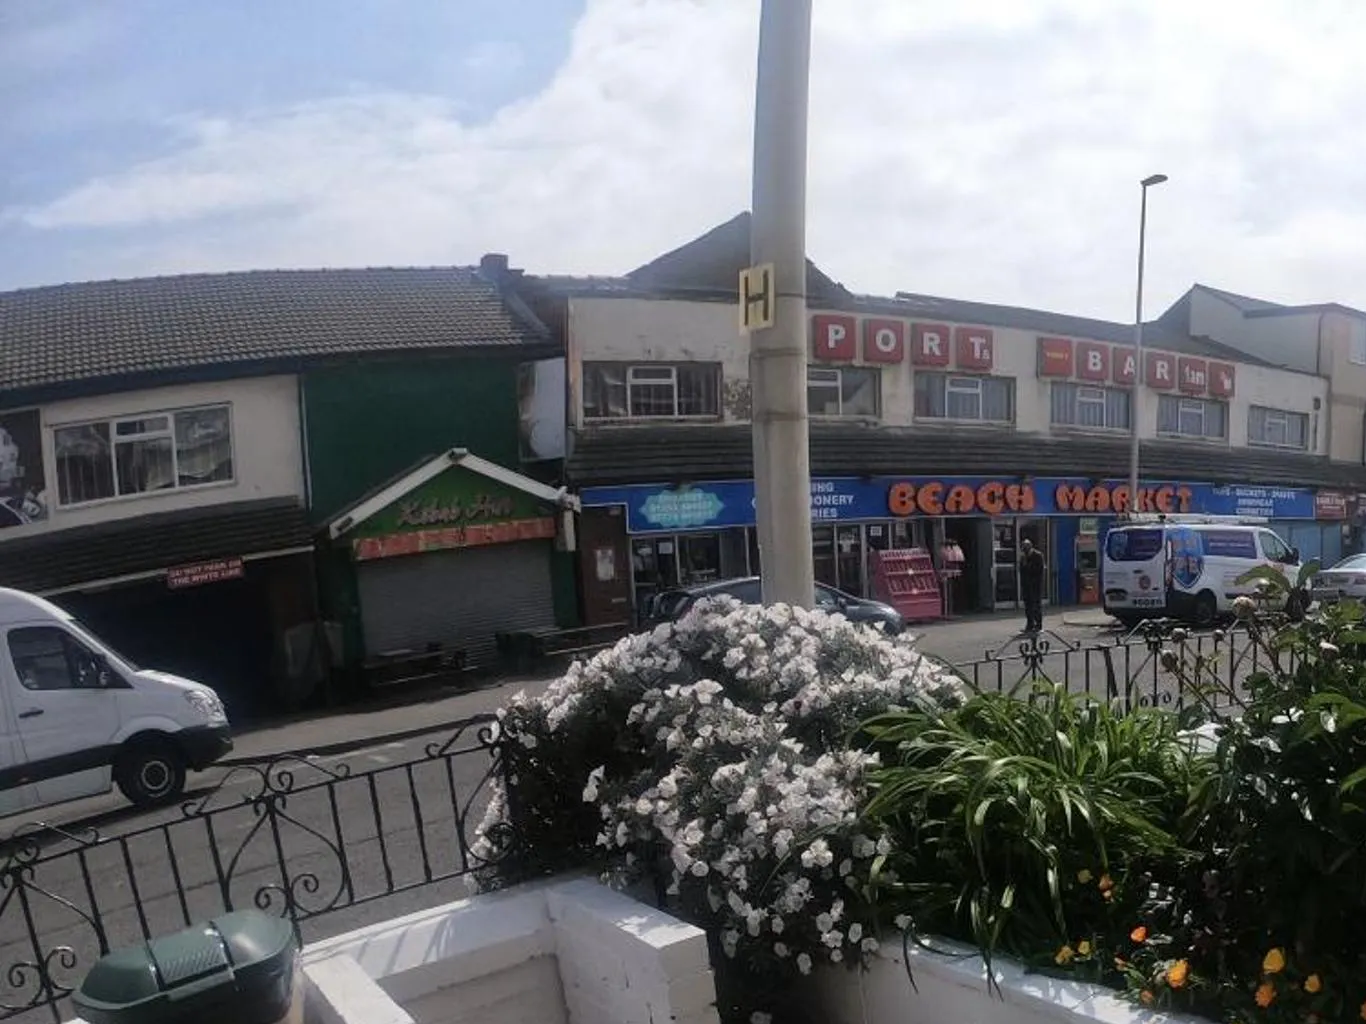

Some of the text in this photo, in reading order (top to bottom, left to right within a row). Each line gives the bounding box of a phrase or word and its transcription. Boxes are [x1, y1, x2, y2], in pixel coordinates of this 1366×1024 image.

[744, 270, 769, 326] H
[889, 481, 1192, 515] BEACH MARKET
